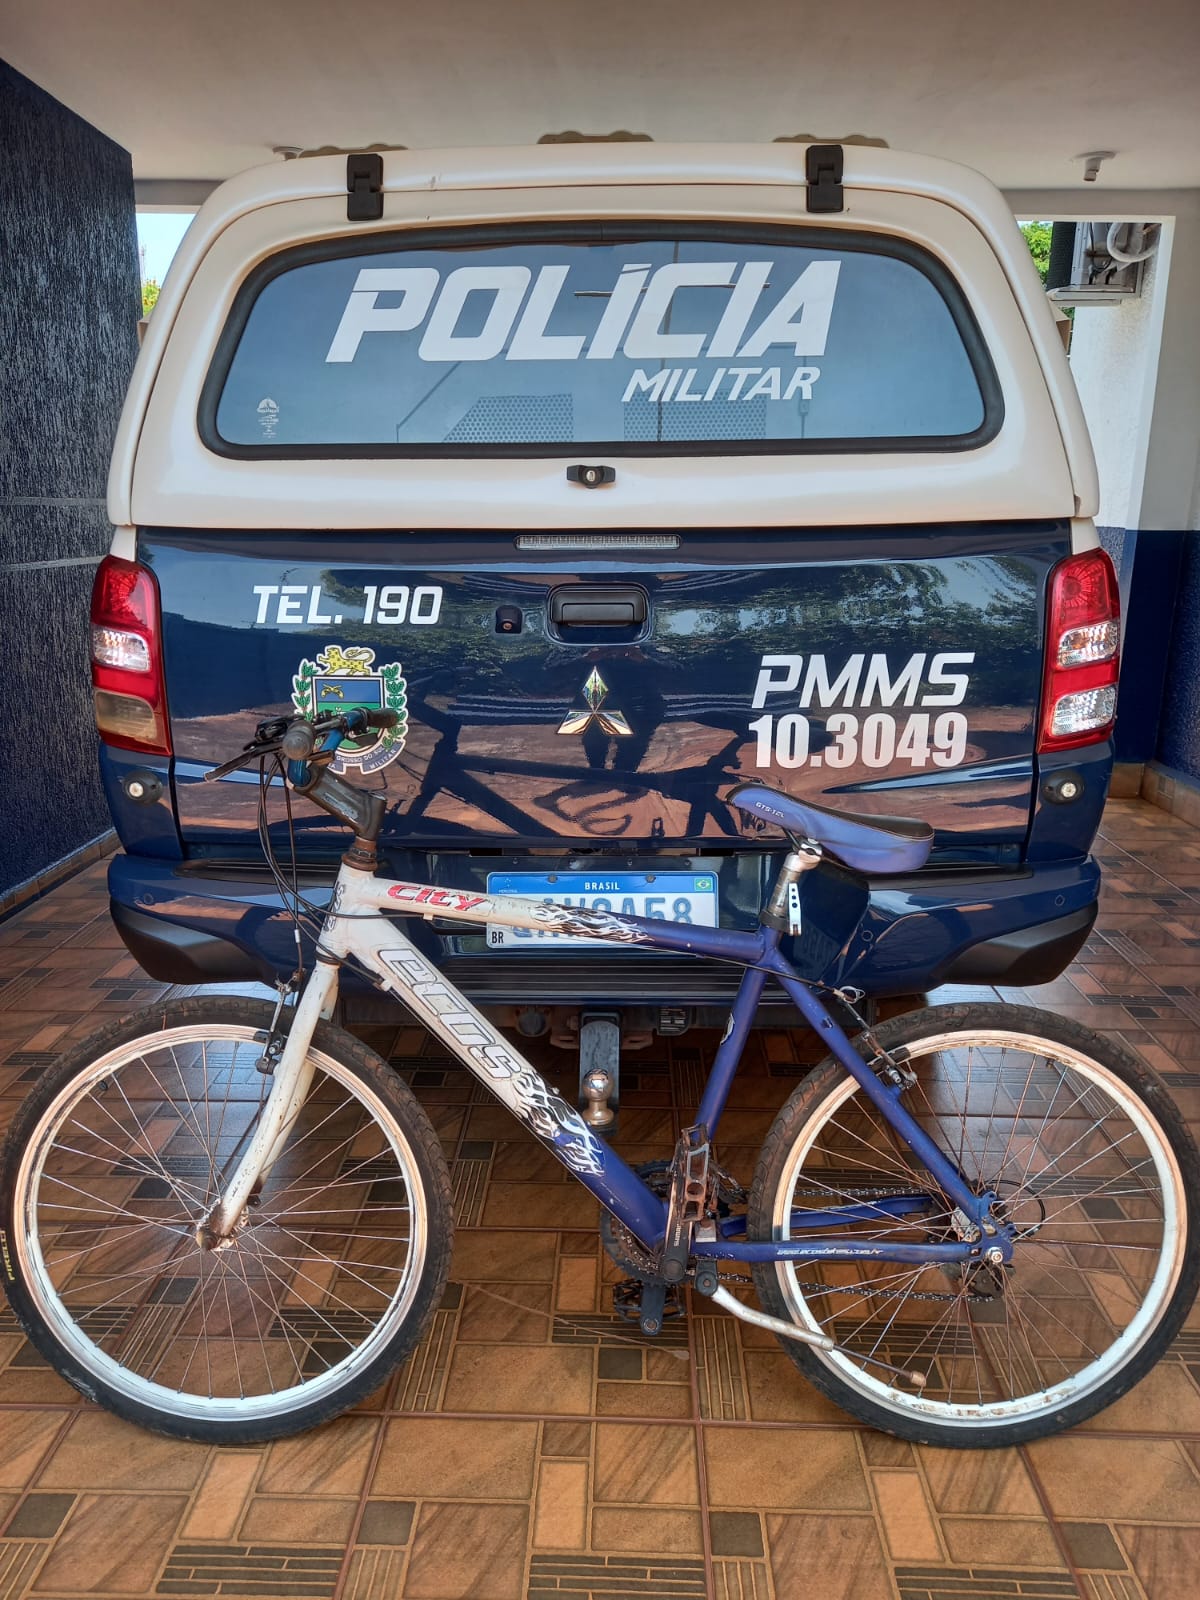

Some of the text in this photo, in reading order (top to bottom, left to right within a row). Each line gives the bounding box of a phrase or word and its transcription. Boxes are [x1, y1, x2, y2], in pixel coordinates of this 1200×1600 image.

[325, 260, 842, 363] POLÍCIA
[622, 367, 820, 403] MILITAR
[253, 585, 443, 625] TEL. 190
[751, 652, 976, 709] PMMS
[369, 749, 397, 769] MILITAR
[748, 712, 969, 769] 10.3049
[584, 881, 620, 891] BRASIL
[491, 931, 504, 944] BR
